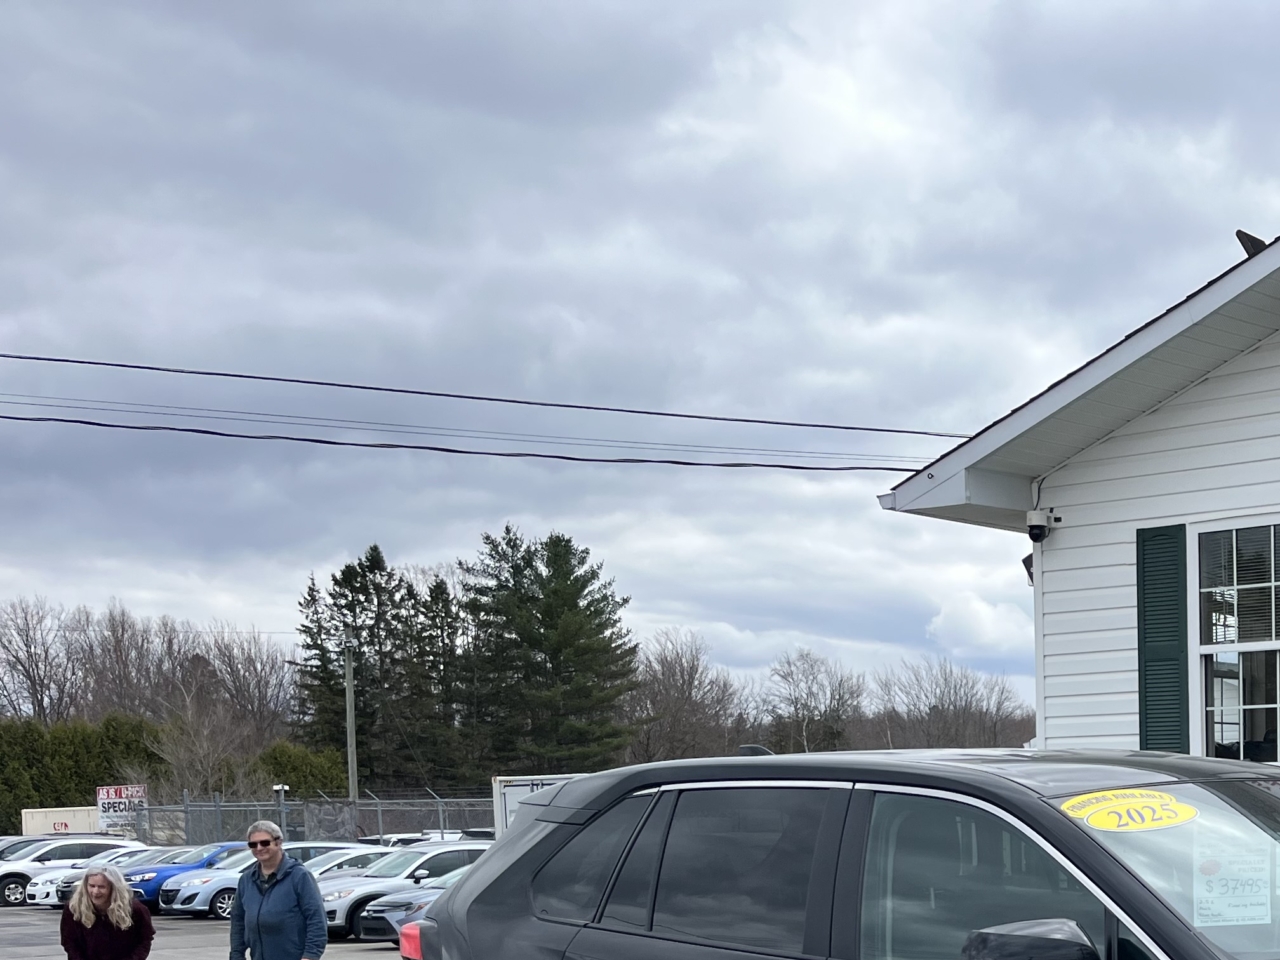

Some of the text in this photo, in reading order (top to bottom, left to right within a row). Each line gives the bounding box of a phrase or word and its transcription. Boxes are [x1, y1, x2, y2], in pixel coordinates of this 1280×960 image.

[98, 788, 108, 799] AS
[109, 788, 116, 798] IS
[1107, 803, 1179, 829] 2025
